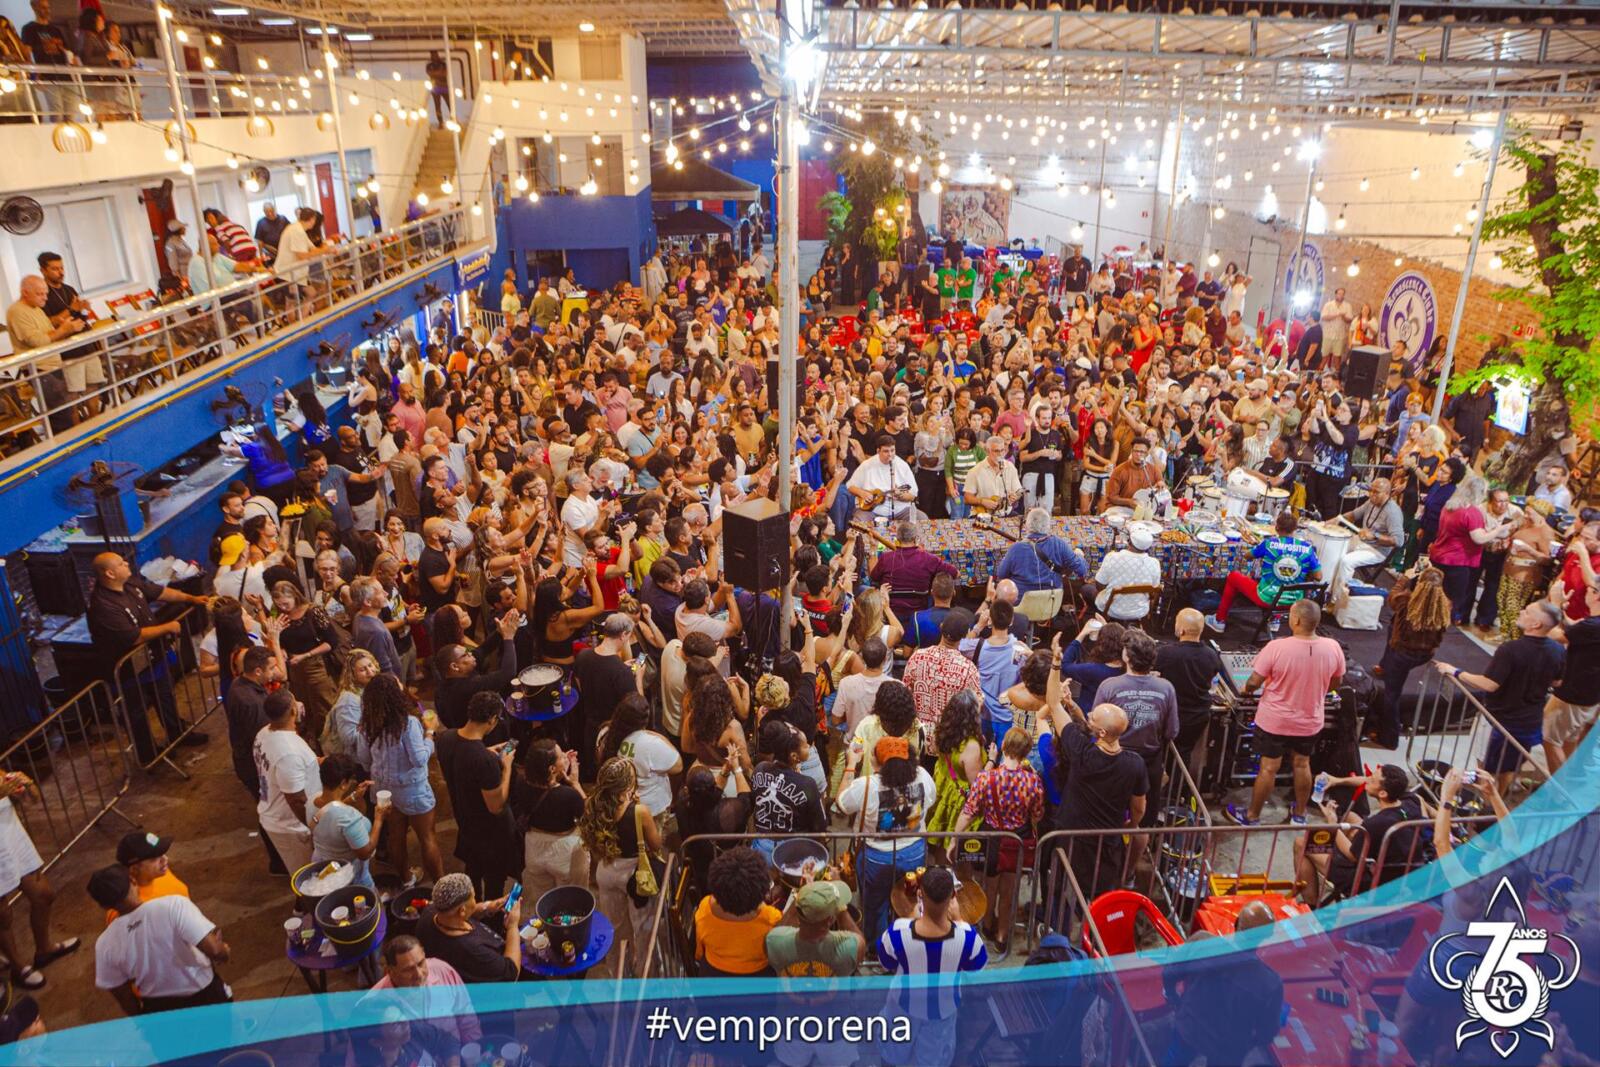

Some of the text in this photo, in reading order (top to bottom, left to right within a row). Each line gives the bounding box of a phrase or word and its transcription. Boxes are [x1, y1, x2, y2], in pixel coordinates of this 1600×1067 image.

[1269, 541, 1310, 553] COMPOSITOR
[752, 771, 808, 806] JORDAN
[756, 796, 793, 832] 23
